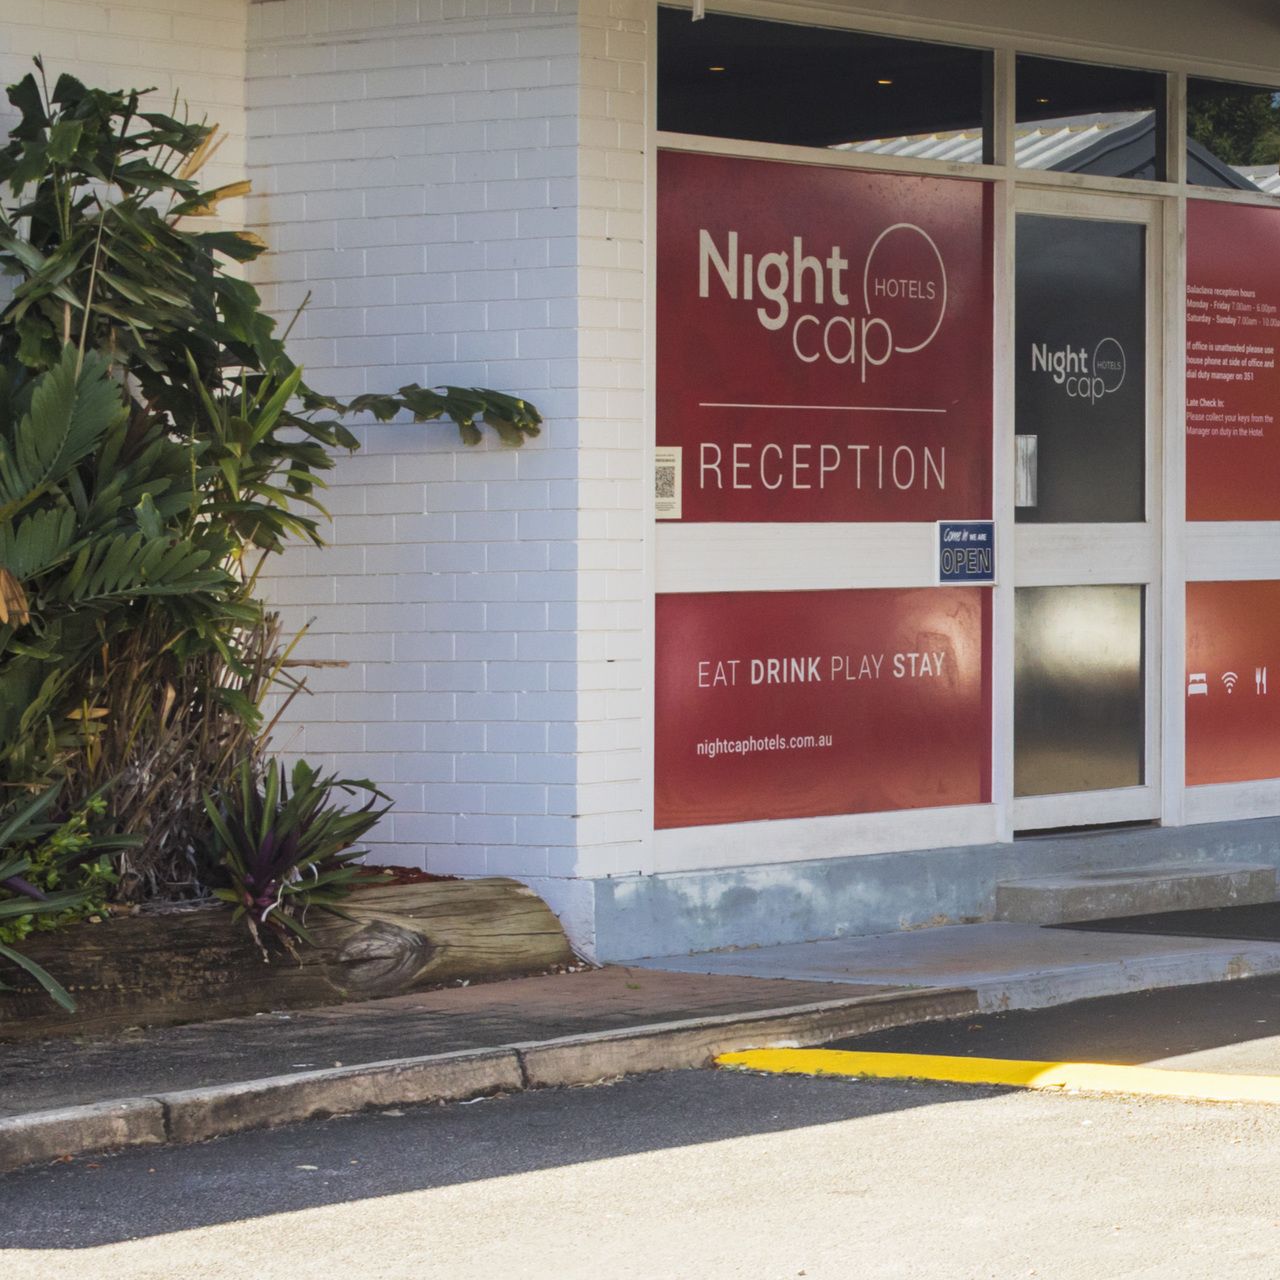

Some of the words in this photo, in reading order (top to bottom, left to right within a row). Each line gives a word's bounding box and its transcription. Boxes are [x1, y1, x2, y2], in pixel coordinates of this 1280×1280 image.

[699, 229, 849, 331] Night
[875, 278, 935, 300] HOTELS
[1214, 288, 1239, 297] reception
[1240, 288, 1256, 298] hours
[1186, 299, 1209, 311] Monday
[1213, 300, 1230, 312] Friday
[1186, 313, 1211, 325] Saturday
[1216, 314, 1236, 326] Sunday
[794, 314, 893, 383] cap
[1191, 341, 1208, 351] office
[1208, 342, 1214, 352] is
[1214, 344, 1246, 353] unattended
[1245, 344, 1264, 355] please
[1264, 347, 1274, 355] use
[1032, 343, 1088, 384] Night
[1097, 360, 1122, 370] HOTELS
[1186, 355, 1204, 365] house
[1204, 356, 1222, 367] phone
[1222, 357, 1229, 366] at
[1229, 357, 1241, 367] side
[1241, 357, 1248, 367] of
[1247, 358, 1264, 368] office
[1264, 359, 1275, 368] and
[1186, 369, 1198, 379] dial
[1197, 370, 1211, 381] duty
[1210, 372, 1235, 382] manager
[1066, 376, 1105, 406] cap
[1186, 398, 1199, 407] Late
[1199, 398, 1217, 407] Check
[1186, 412, 1205, 421] Please
[1205, 413, 1224, 422] collect
[1224, 415, 1237, 424] your
[1237, 413, 1251, 424] keys
[1251, 413, 1264, 423] from
[1264, 414, 1274, 424] the
[1186, 426, 1211, 438] Manager
[1211, 428, 1219, 436] on
[1219, 426, 1232, 437] duty
[1232, 427, 1239, 436] in
[1238, 427, 1249, 437] the
[700, 442, 945, 490] RECEPTION
[943, 528, 961, 542] Come
[969, 533, 977, 541] WE
[977, 533, 987, 541] ARE
[942, 548, 991, 574] OPEN
[698, 660, 740, 688] EAT
[751, 656, 822, 684] DRINK
[831, 654, 885, 681] PLAY
[893, 651, 946, 678] STAY
[697, 734, 833, 759] nightcaphotels.com.au
